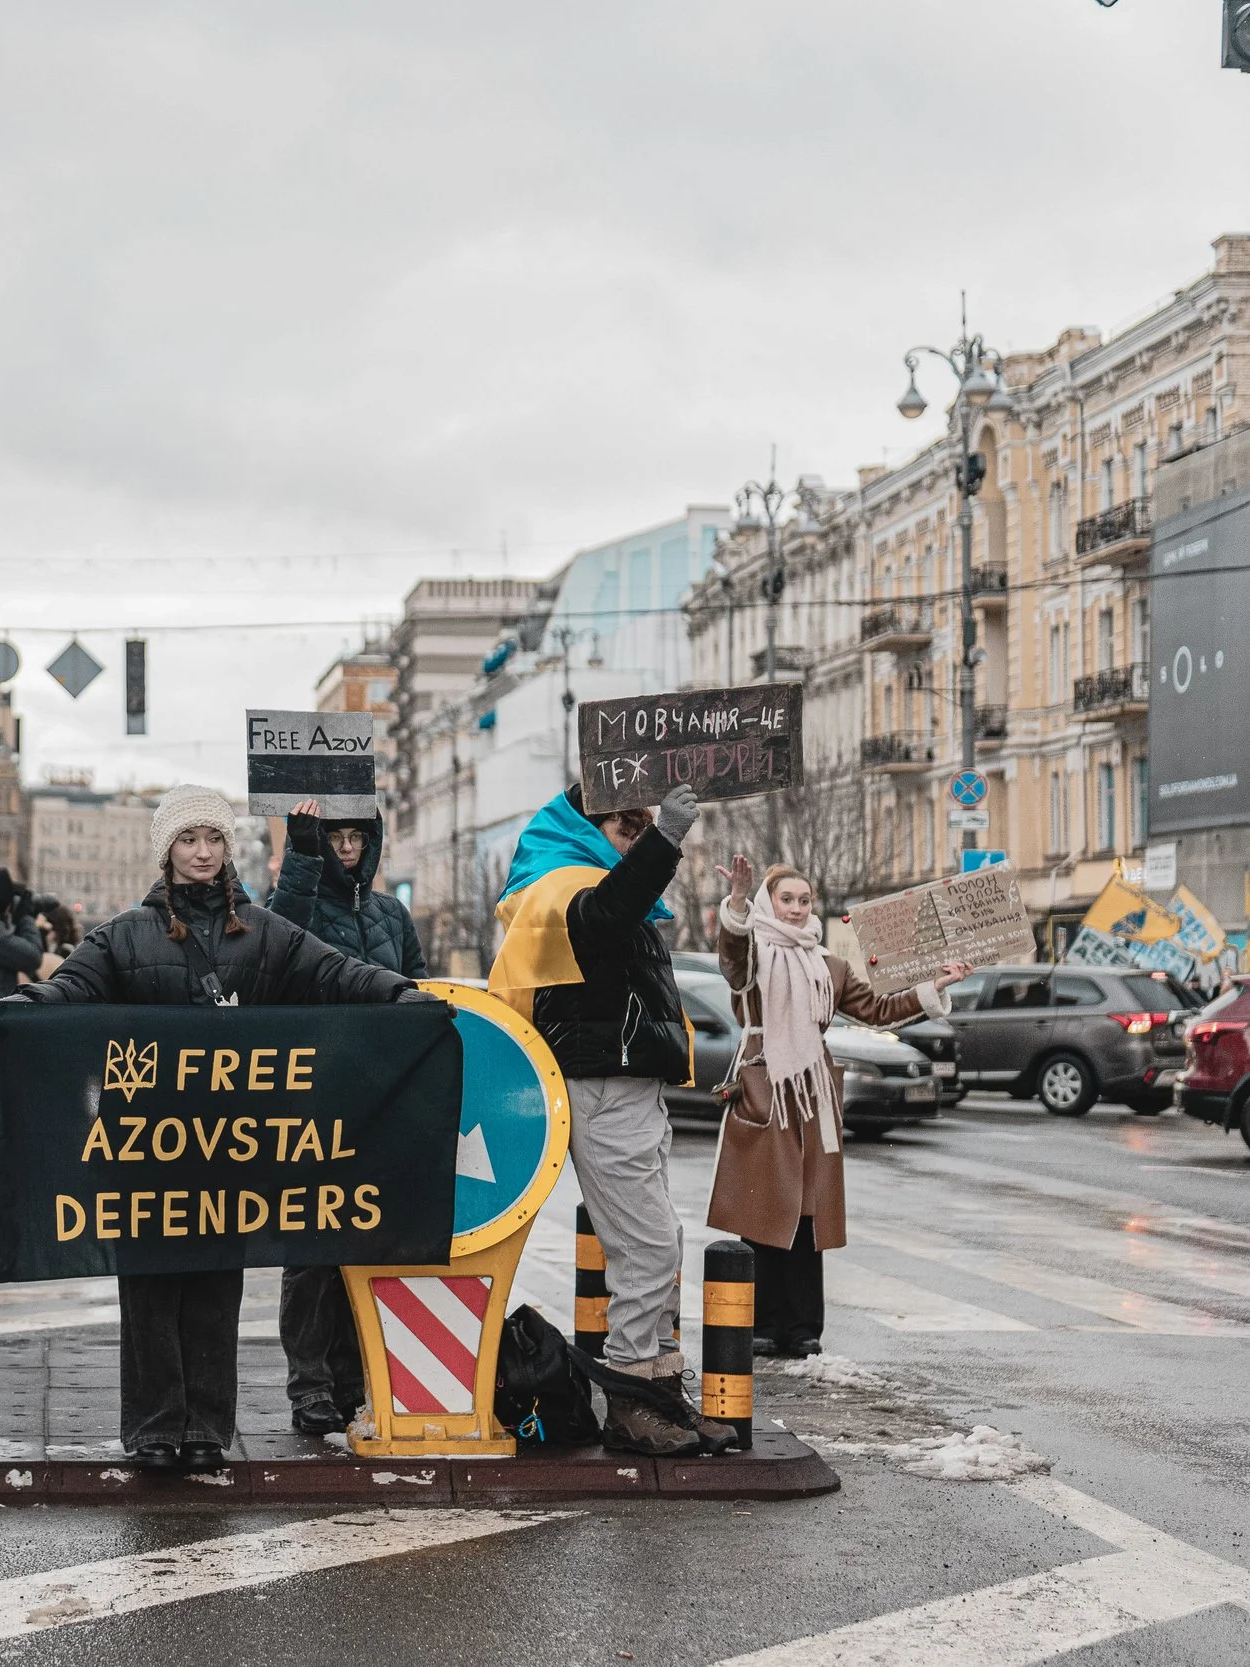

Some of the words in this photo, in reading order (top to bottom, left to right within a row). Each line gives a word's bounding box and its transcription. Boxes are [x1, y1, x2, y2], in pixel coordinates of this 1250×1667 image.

[1160, 645, 1224, 693] SOLO
[597, 752, 649, 792] ТЕЖ
[661, 744, 774, 786] ТОРТУРИ
[947, 874, 998, 896] ПОЛОН
[948, 894, 1006, 917] КАТУВАННЯ
[958, 884, 1004, 904] ГОЛОД
[906, 968, 937, 984] ВОЛЮ
[177, 1048, 316, 1091] FREE
[81, 1116, 356, 1162] AZOVSTAL
[56, 1184, 382, 1242] DEFENDERS
